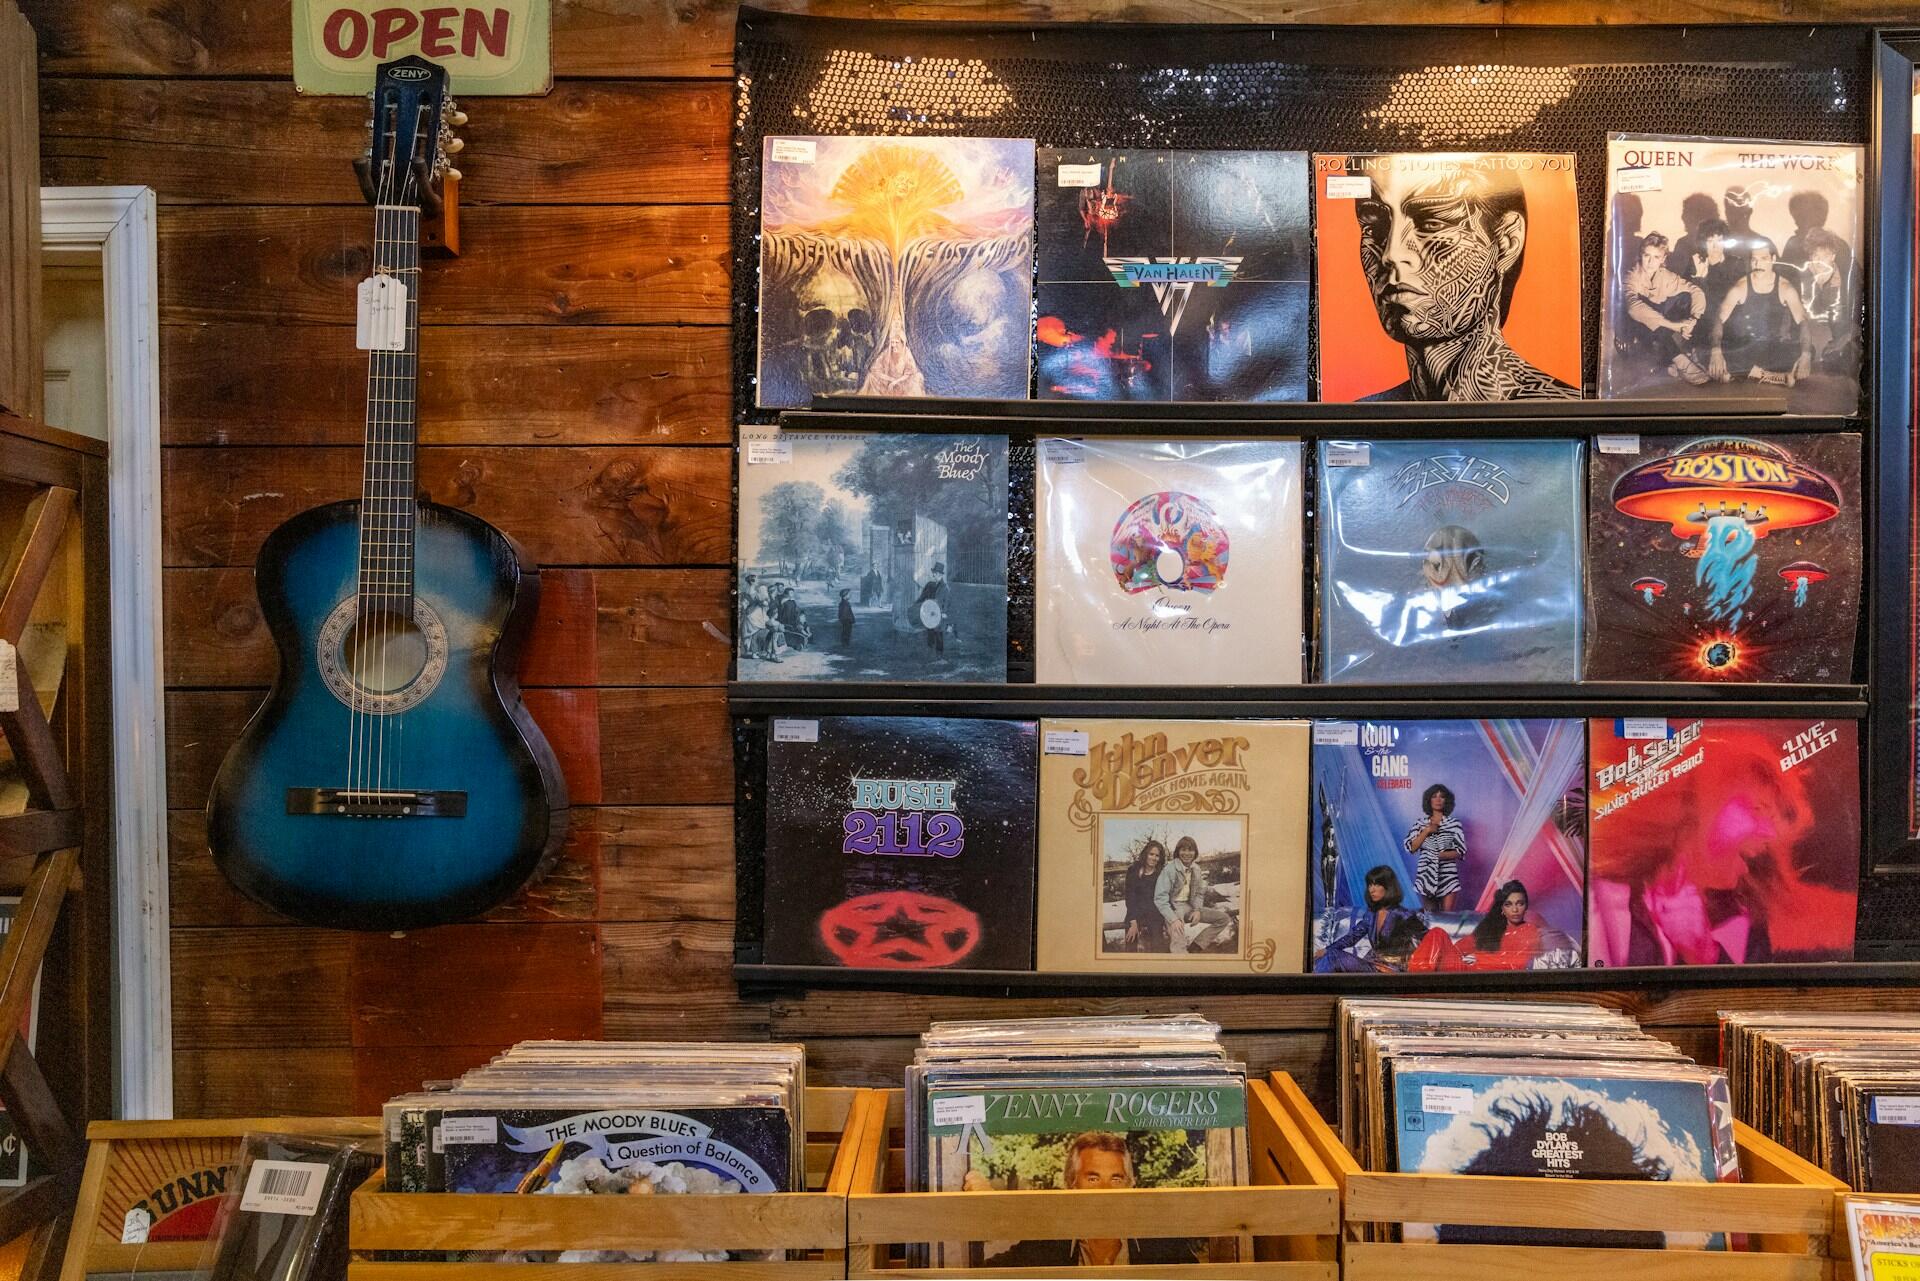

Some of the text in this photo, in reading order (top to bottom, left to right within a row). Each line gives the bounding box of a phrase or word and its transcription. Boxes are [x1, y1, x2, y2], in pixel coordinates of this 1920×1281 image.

[323, 7, 510, 58] OPEN
[1318, 158, 1391, 171] ROLLING
[1471, 157, 1534, 170] TATTOO
[1539, 158, 1572, 171] YOU
[1624, 150, 1841, 172] QUEEN THE WORK
[1134, 266, 1215, 280] VAN HALEN
[954, 437, 980, 453] The
[934, 446, 990, 473] Moody
[1670, 454, 1790, 483] BOSTON
[937, 462, 976, 481] Blues
[1113, 617, 1231, 634] A Night At The Opera
[1361, 725, 1396, 747] KOOL
[1073, 732, 1168, 789] John
[1595, 720, 1704, 791] Bob Seger
[1780, 728, 1838, 773] BULLET
[1093, 736, 1250, 810] Denver
[1372, 755, 1409, 777] GANG
[1168, 775, 1208, 793] HOME
[1208, 772, 1250, 792] AGAIN
[853, 780, 956, 811] RUSH
[843, 810, 964, 858] 2112
[1104, 1090, 1222, 1125] ROGERS
[546, 1115, 697, 1142] THE MOODY BLUES
[1167, 1116, 1194, 1127] YOUR
[1536, 1140, 1579, 1151] DYLAN'S
[1545, 1132, 1568, 1141] BOB
[617, 1143, 682, 1159] Question
[686, 1141, 702, 1154] of
[705, 1143, 760, 1185] Balance
[1531, 1149, 1584, 1160] GREATEST
[1546, 1158, 1571, 1168] HITS
